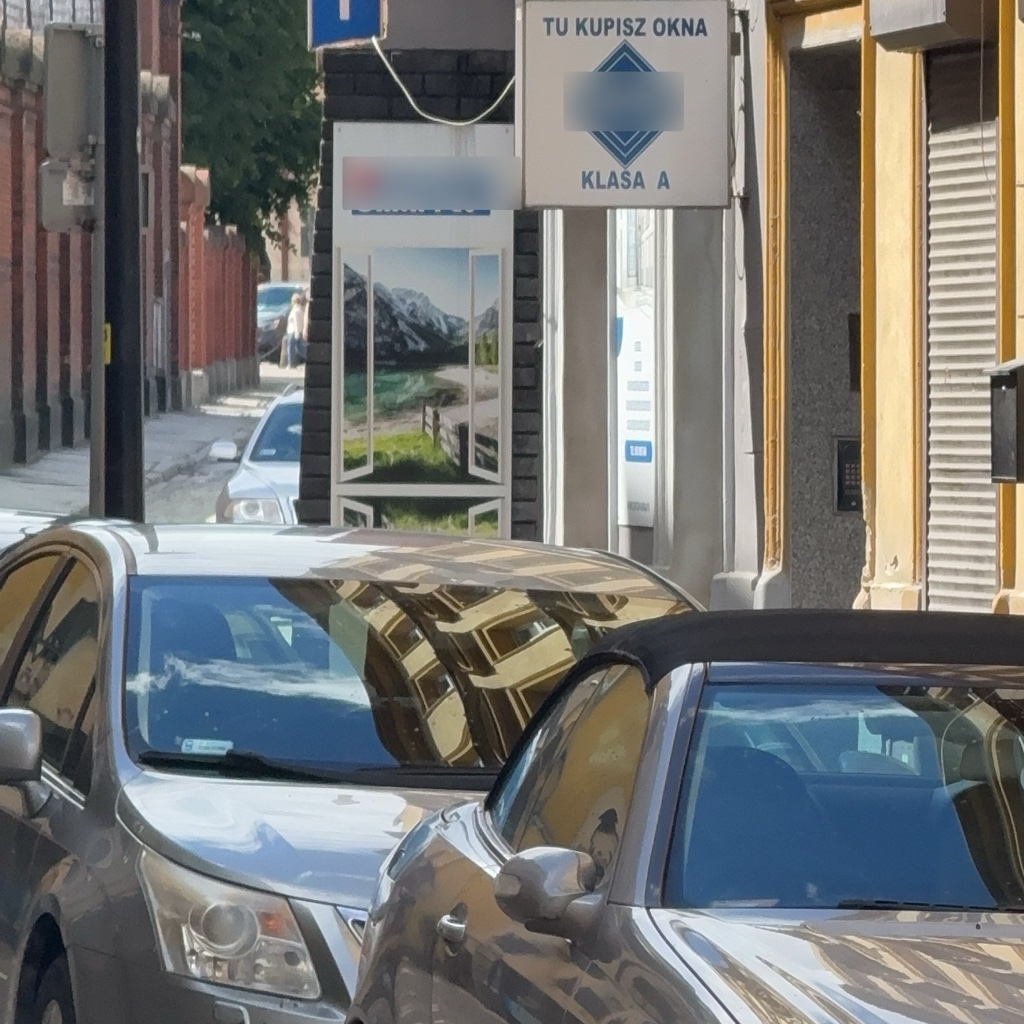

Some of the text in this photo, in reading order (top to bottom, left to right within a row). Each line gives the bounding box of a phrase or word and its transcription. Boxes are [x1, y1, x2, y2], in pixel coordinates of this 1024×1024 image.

[543, 17, 707, 37] TU KUPISZ OKNA
[581, 170, 671, 190] KLASA A
